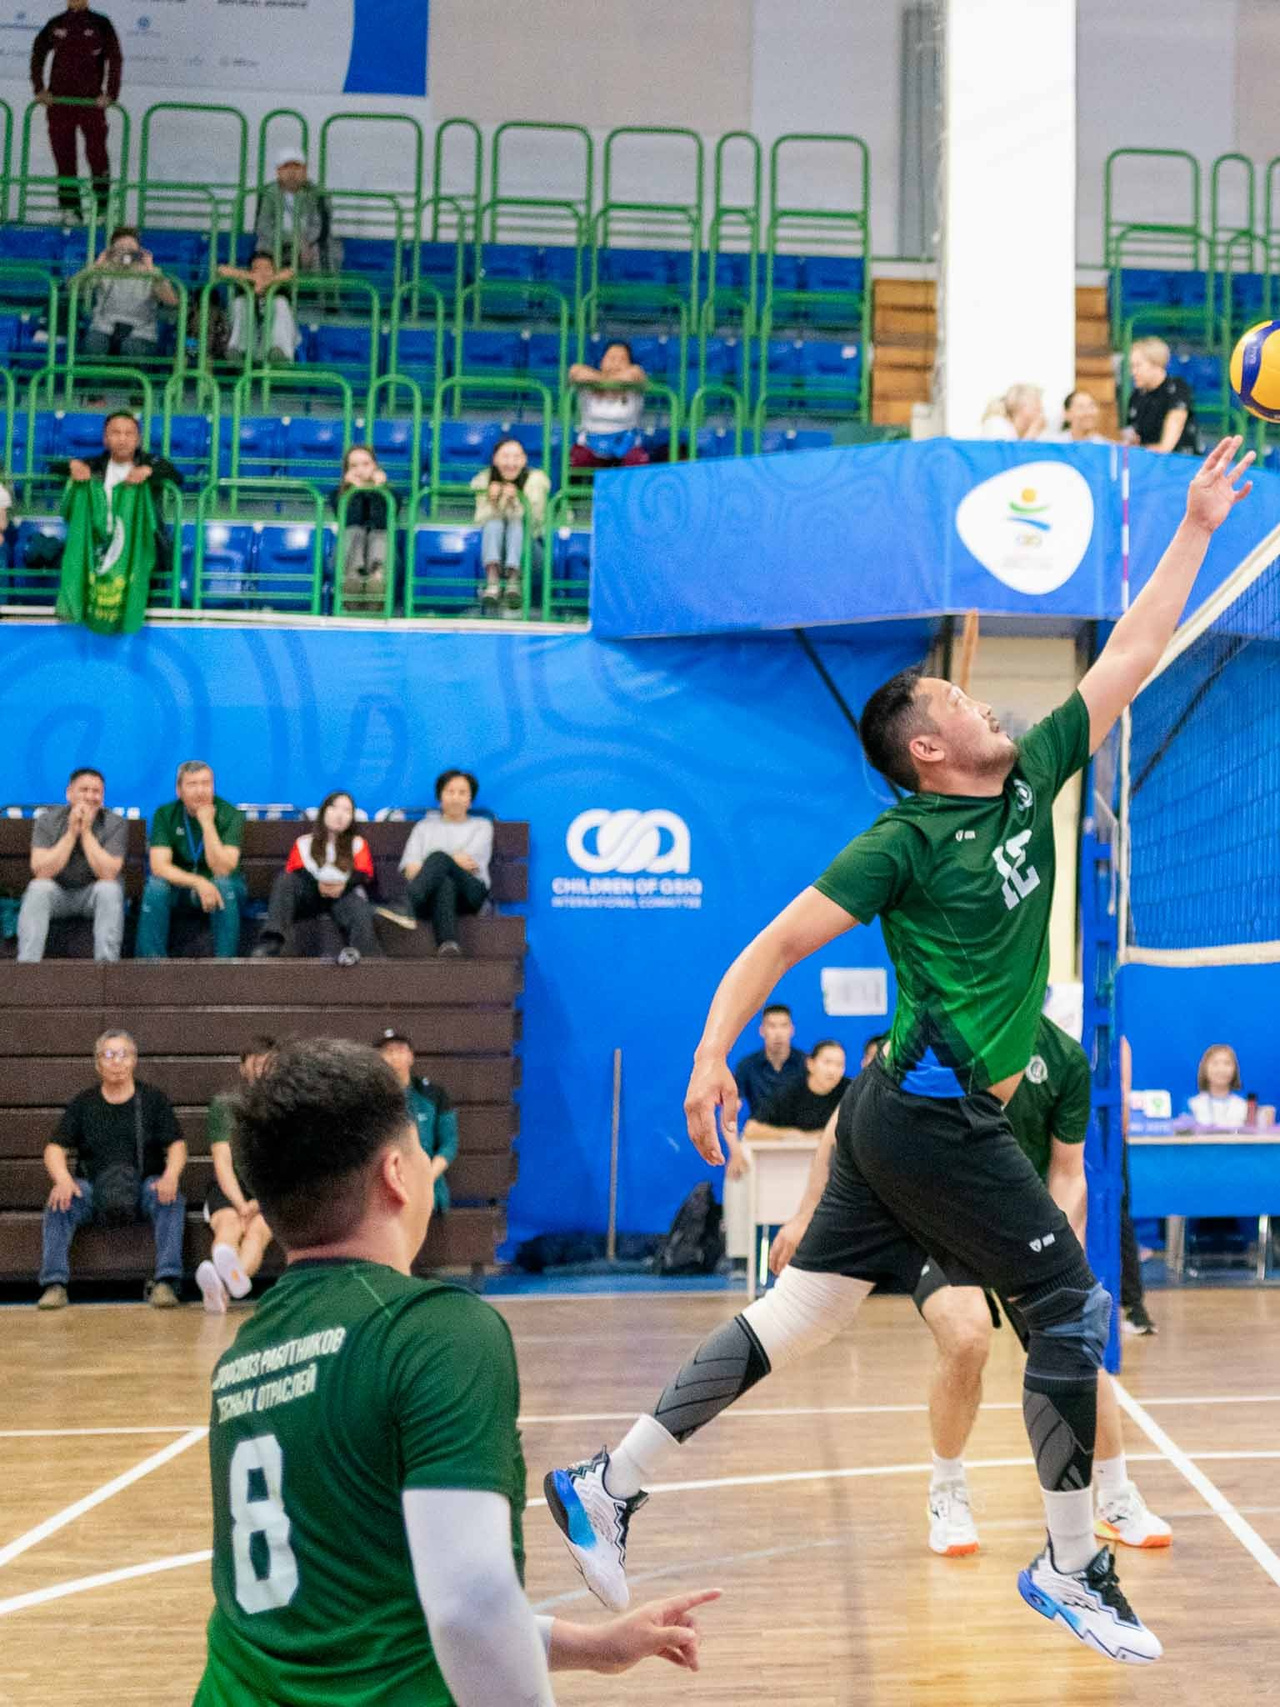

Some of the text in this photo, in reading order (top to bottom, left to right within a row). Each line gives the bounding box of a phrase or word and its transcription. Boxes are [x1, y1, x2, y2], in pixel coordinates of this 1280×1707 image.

[552, 877, 633, 895] CHILDREN
[635, 877, 657, 895] OF
[992, 829, 1040, 910] 12
[260, 1326, 346, 1374] РАБОТНИКОВ
[230, 1434, 299, 1615] 8
